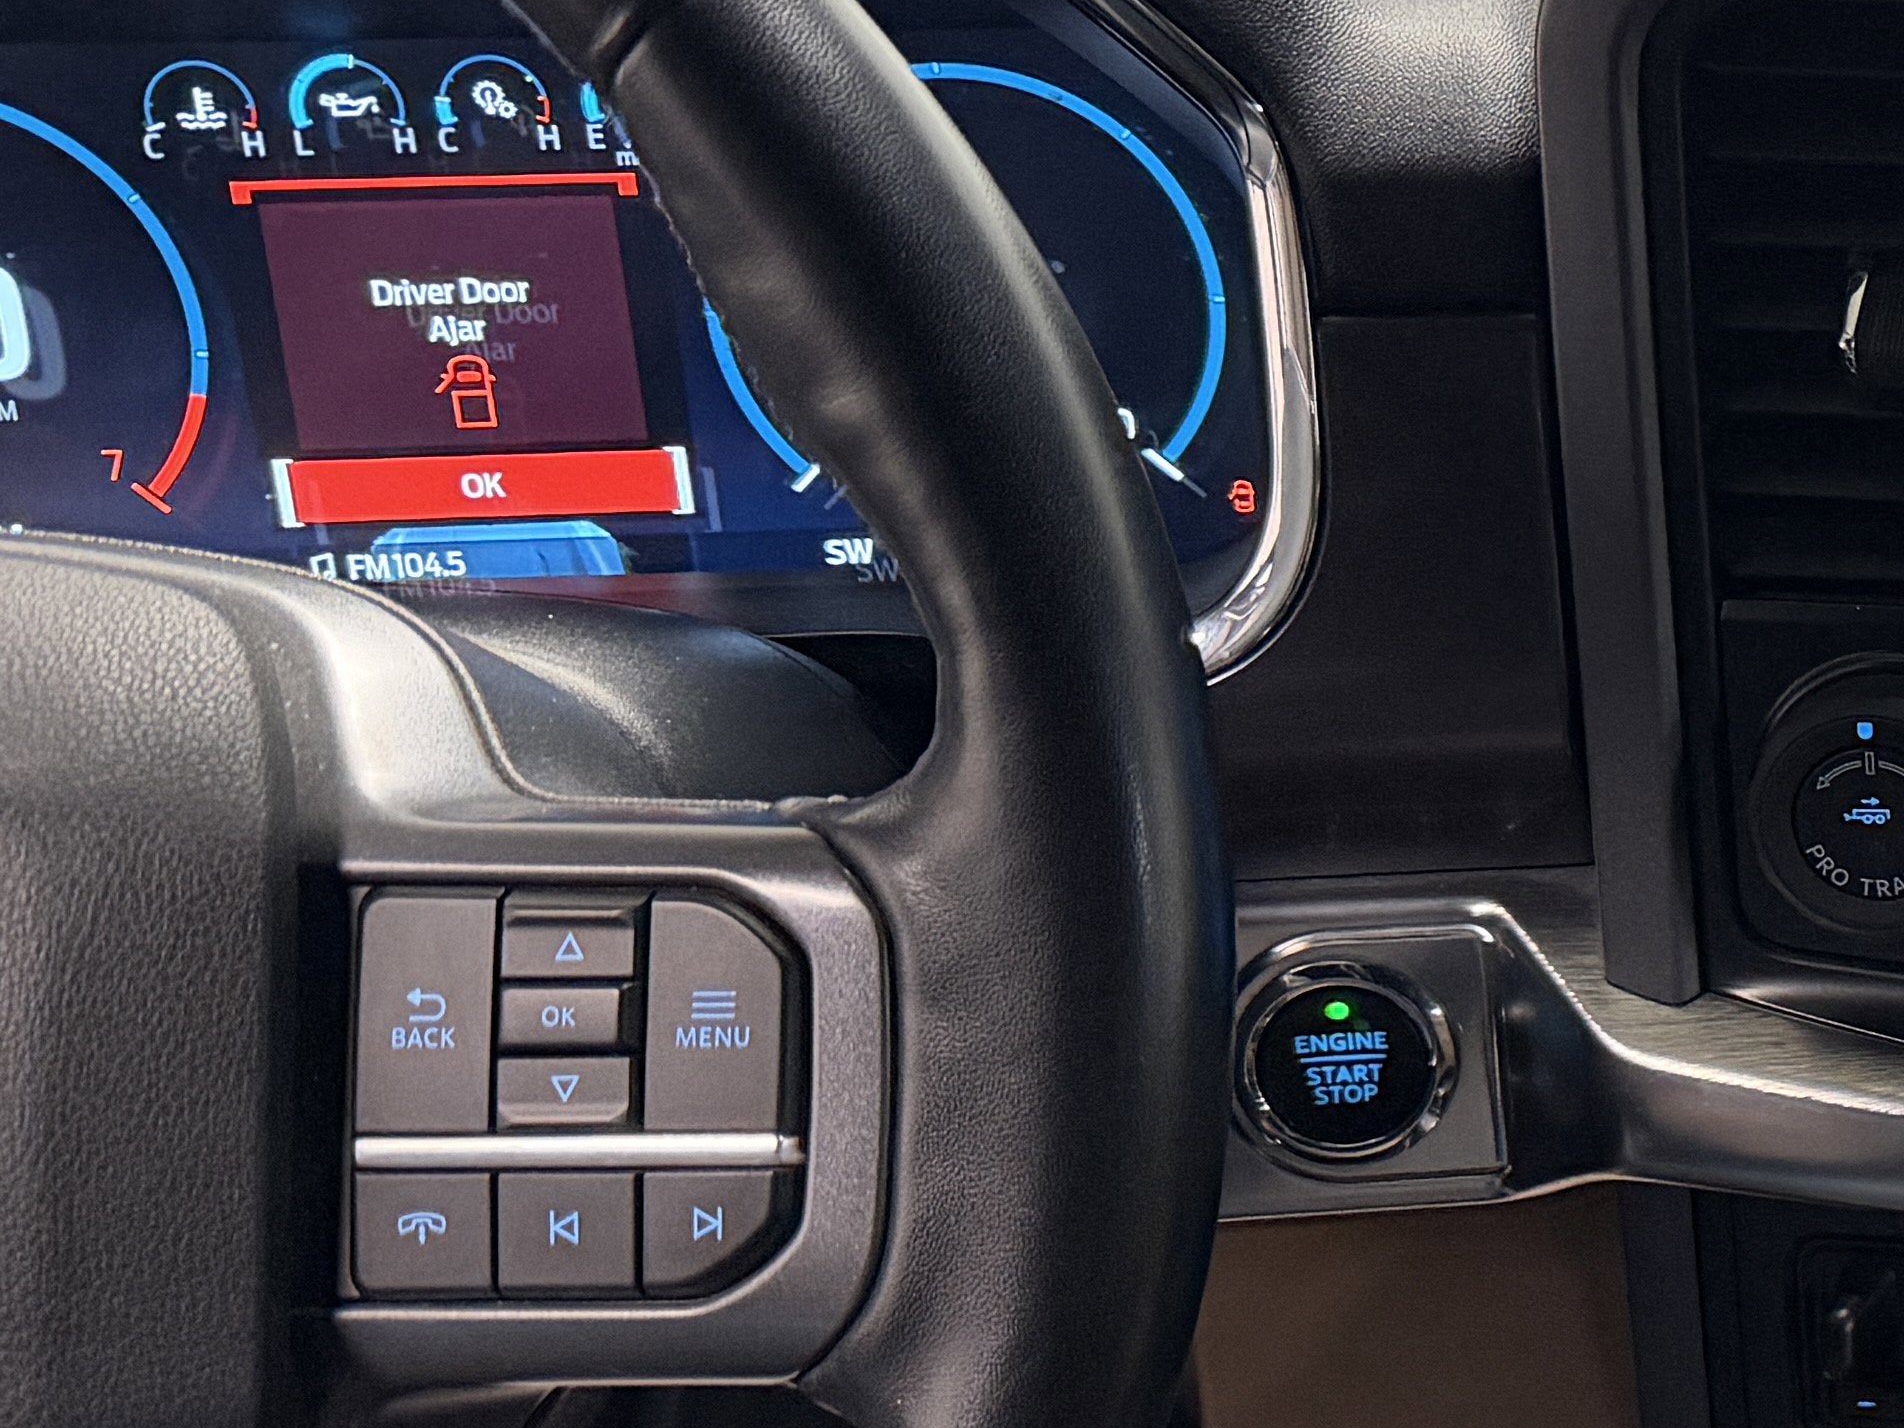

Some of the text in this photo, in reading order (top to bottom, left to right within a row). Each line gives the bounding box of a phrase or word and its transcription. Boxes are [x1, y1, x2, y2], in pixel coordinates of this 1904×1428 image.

[143, 131, 267, 159] C H
[293, 128, 418, 157] L H
[437, 124, 562, 154] C H
[585, 123, 607, 150] E
[369, 276, 531, 309] Driver Door
[428, 314, 487, 346] Ajar
[100, 448, 123, 483] 7
[460, 471, 507, 501] OK
[823, 538, 874, 566] SW
[1804, 843, 1850, 887] PRO
[540, 1004, 576, 1028] OK
[390, 1026, 456, 1051] BACK
[674, 1025, 751, 1050] MENU
[1292, 1030, 1390, 1055] ENGINE
[1304, 1062, 1384, 1087] START
[1312, 1083, 1379, 1107] STOP
